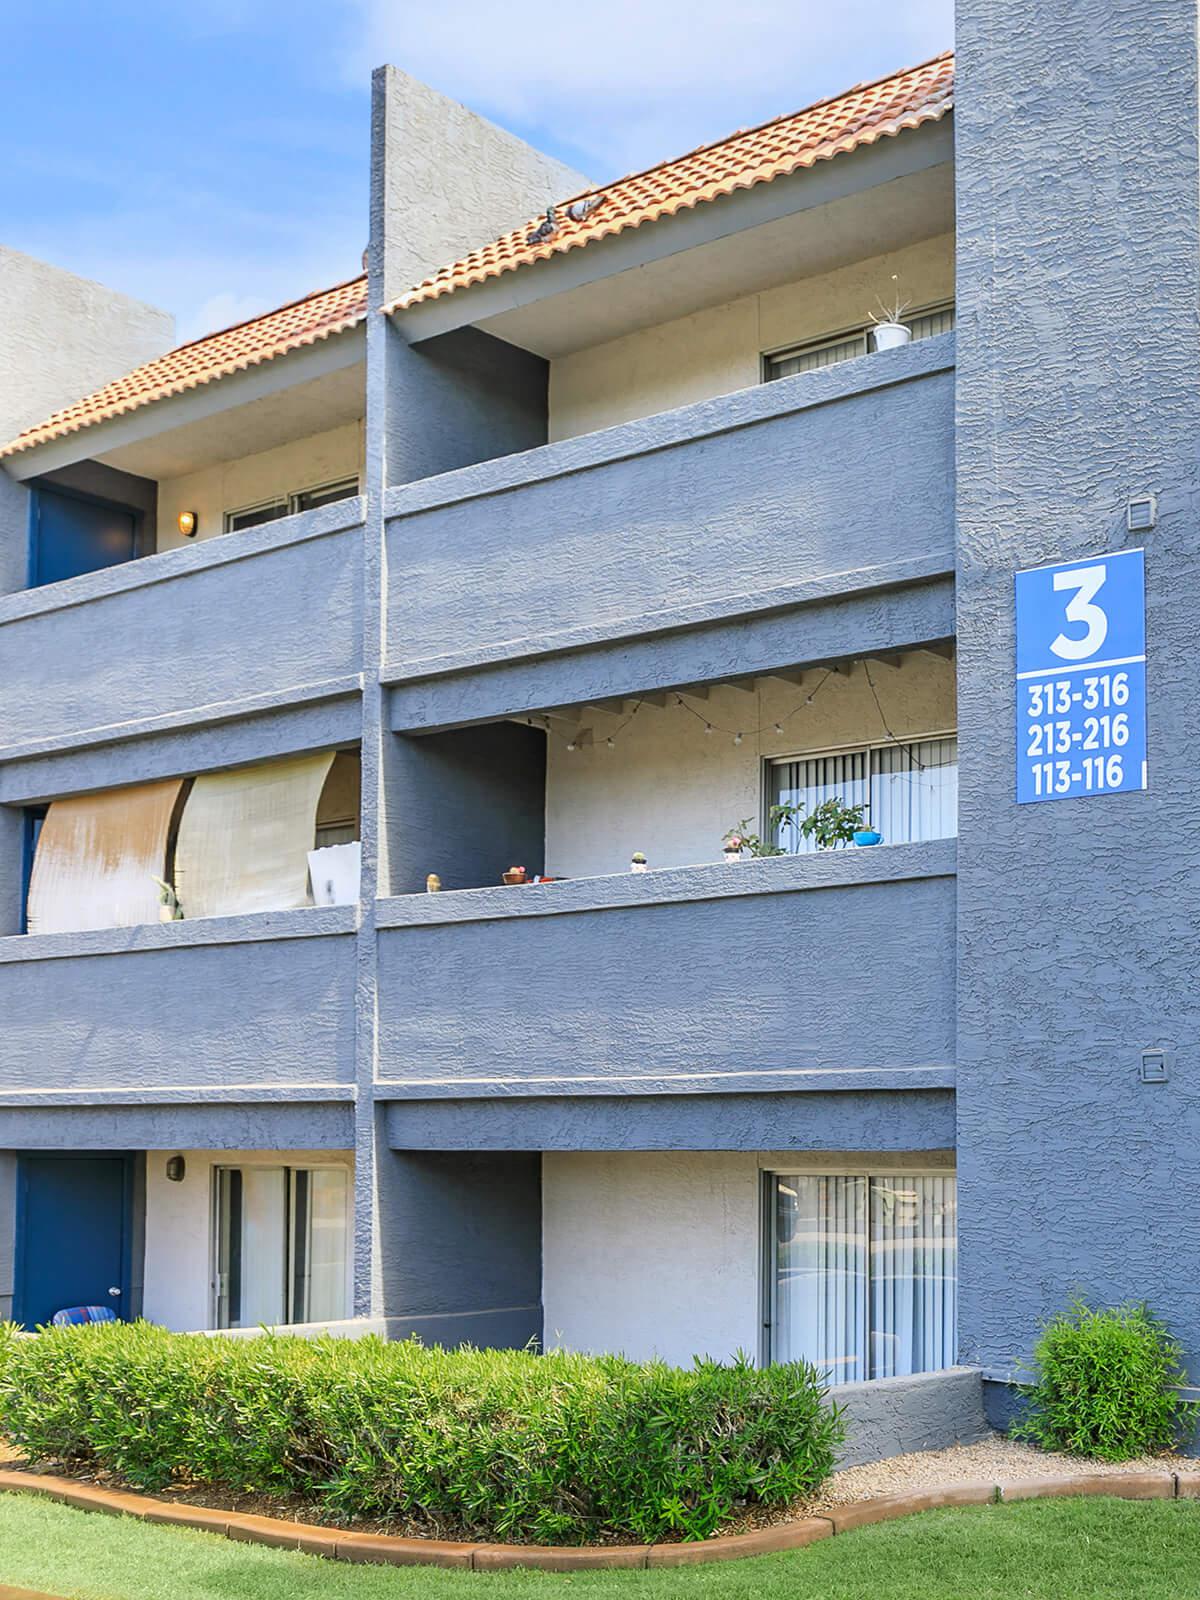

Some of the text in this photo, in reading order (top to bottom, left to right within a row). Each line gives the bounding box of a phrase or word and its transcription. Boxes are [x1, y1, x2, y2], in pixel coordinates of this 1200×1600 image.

[1049, 564, 1108, 660] 3
[1028, 672, 1129, 717] 313-316
[1027, 713, 1129, 757] 213-216
[1031, 754, 1124, 795] 113-116
